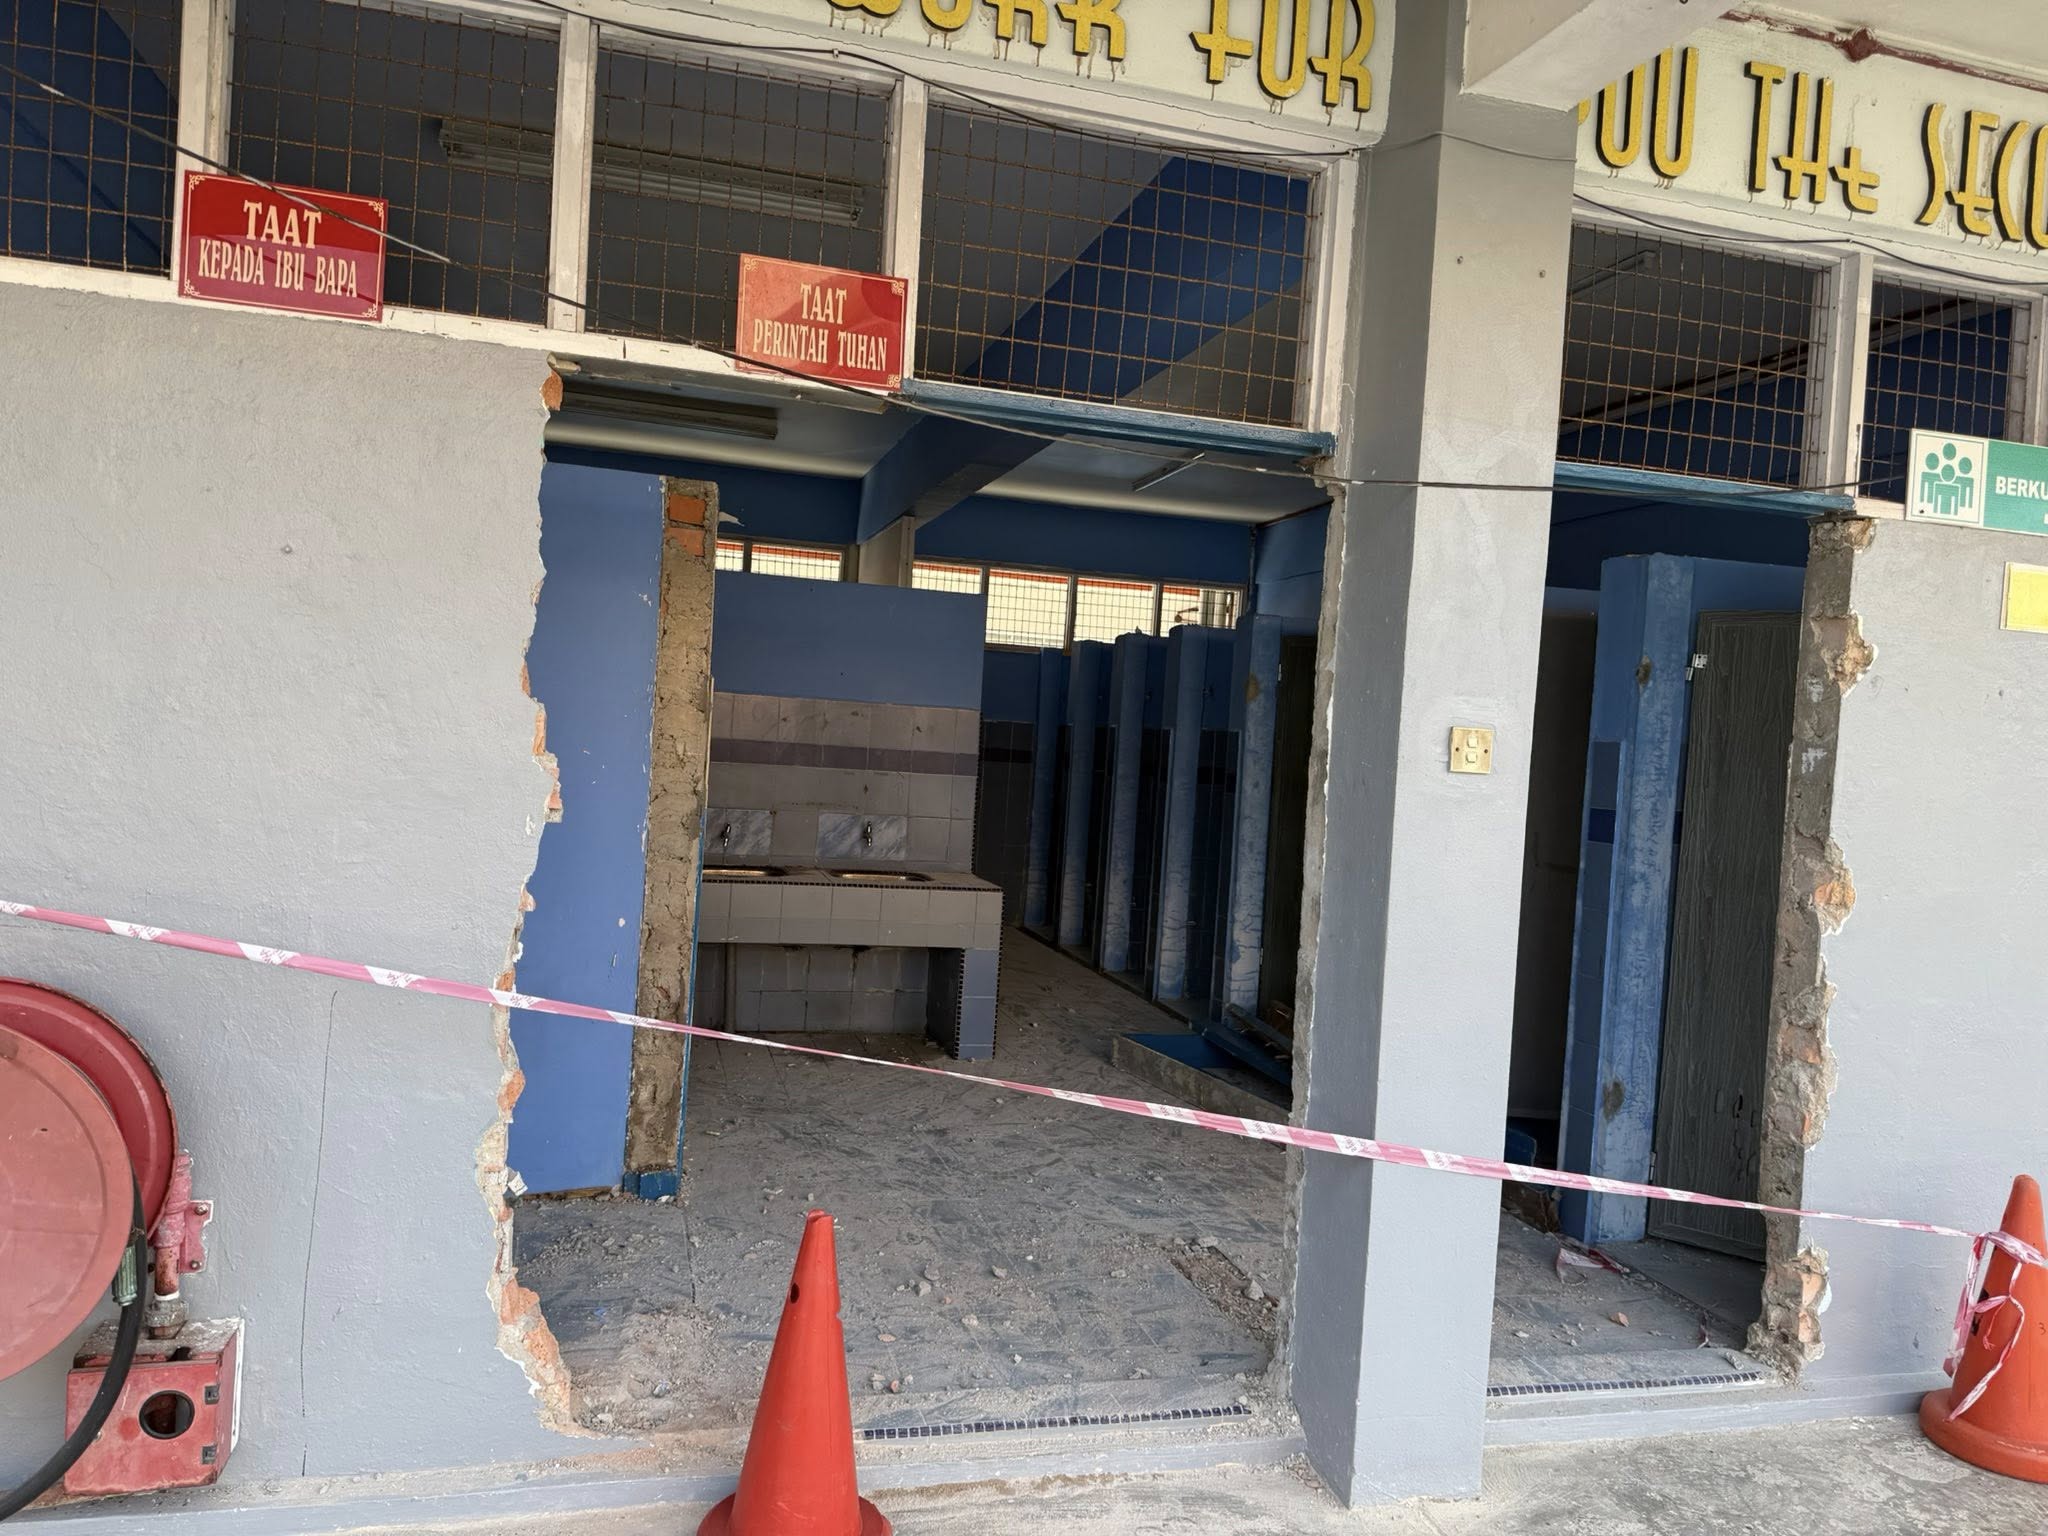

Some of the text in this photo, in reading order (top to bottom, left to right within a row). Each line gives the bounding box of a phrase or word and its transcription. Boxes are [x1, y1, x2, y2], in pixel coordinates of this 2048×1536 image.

[1577, 43, 1700, 180] OU
[1744, 60, 1880, 214] THE
[243, 199, 322, 249] TAAT
[198, 238, 358, 298] KEPADA IBU BAPA
[800, 283, 847, 325] TAAT
[752, 318, 888, 372] PERINTAH TUHAN
